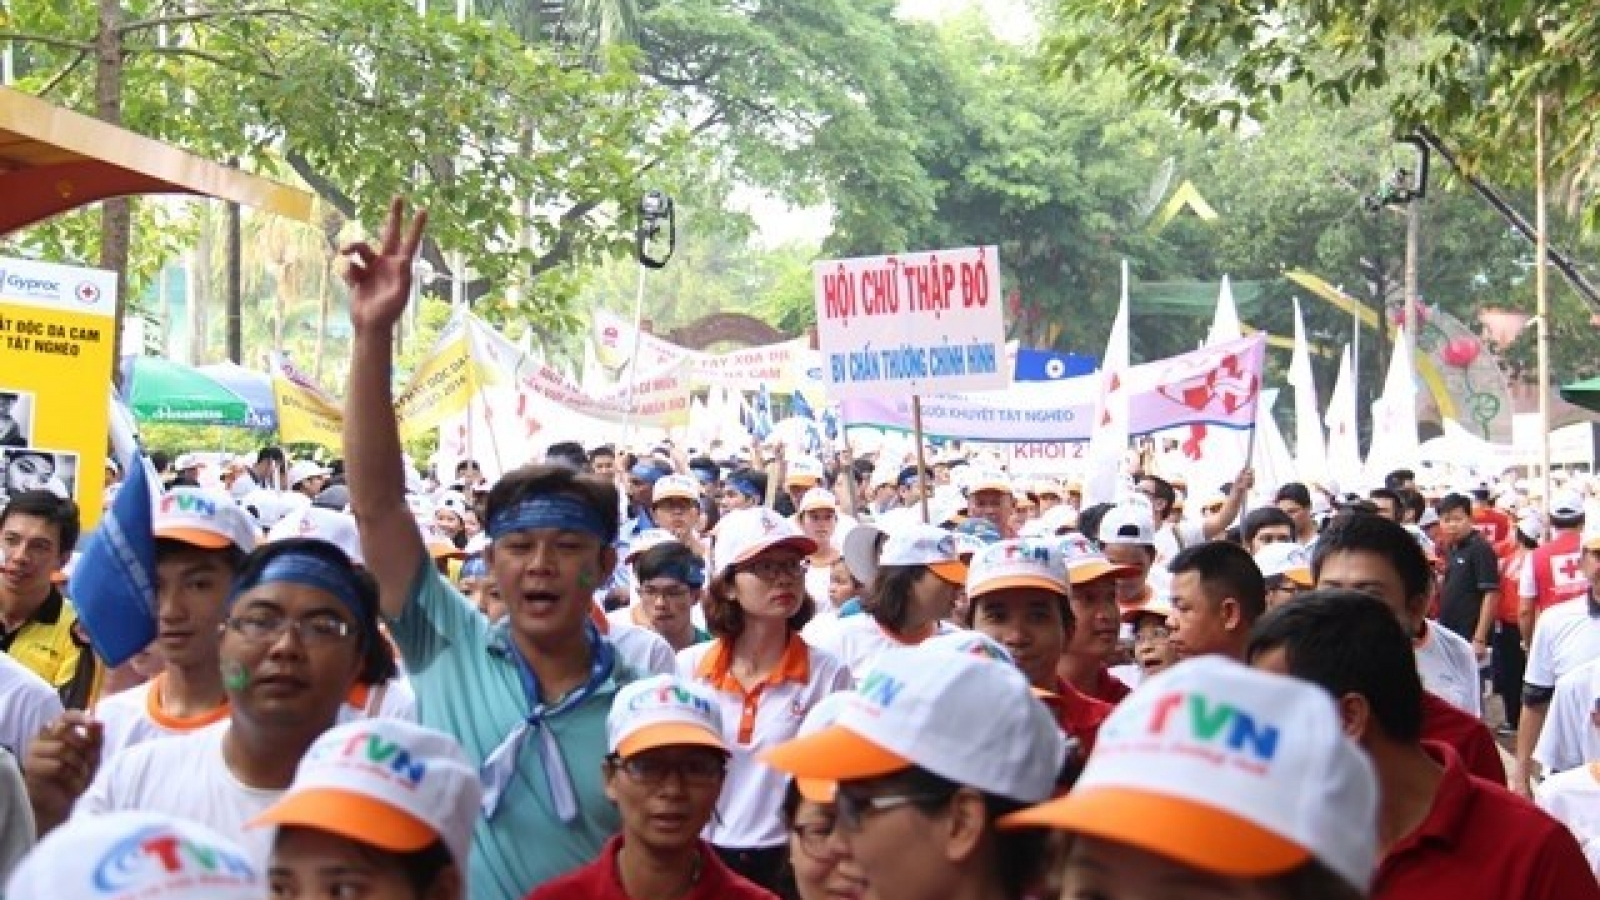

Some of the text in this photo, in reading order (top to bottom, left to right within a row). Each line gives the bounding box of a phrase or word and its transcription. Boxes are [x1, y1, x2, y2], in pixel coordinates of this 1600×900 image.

[7, 274, 60, 291] Gyproc
[823, 246, 988, 327] HỘI CHỮ THẬP ĐỎ
[17, 320, 43, 336] ĐỘC
[47, 324, 66, 339] DA
[70, 328, 100, 343] CAM
[830, 335, 995, 383] BV CHẤN THƯƠNG CHỈNH HÌNH
[919, 404, 946, 418] GƯỜI
[1072, 442, 1084, 459] 2
[159, 494, 216, 516] TVN
[1147, 691, 1280, 762] TVN
[342, 730, 426, 785] TVN
